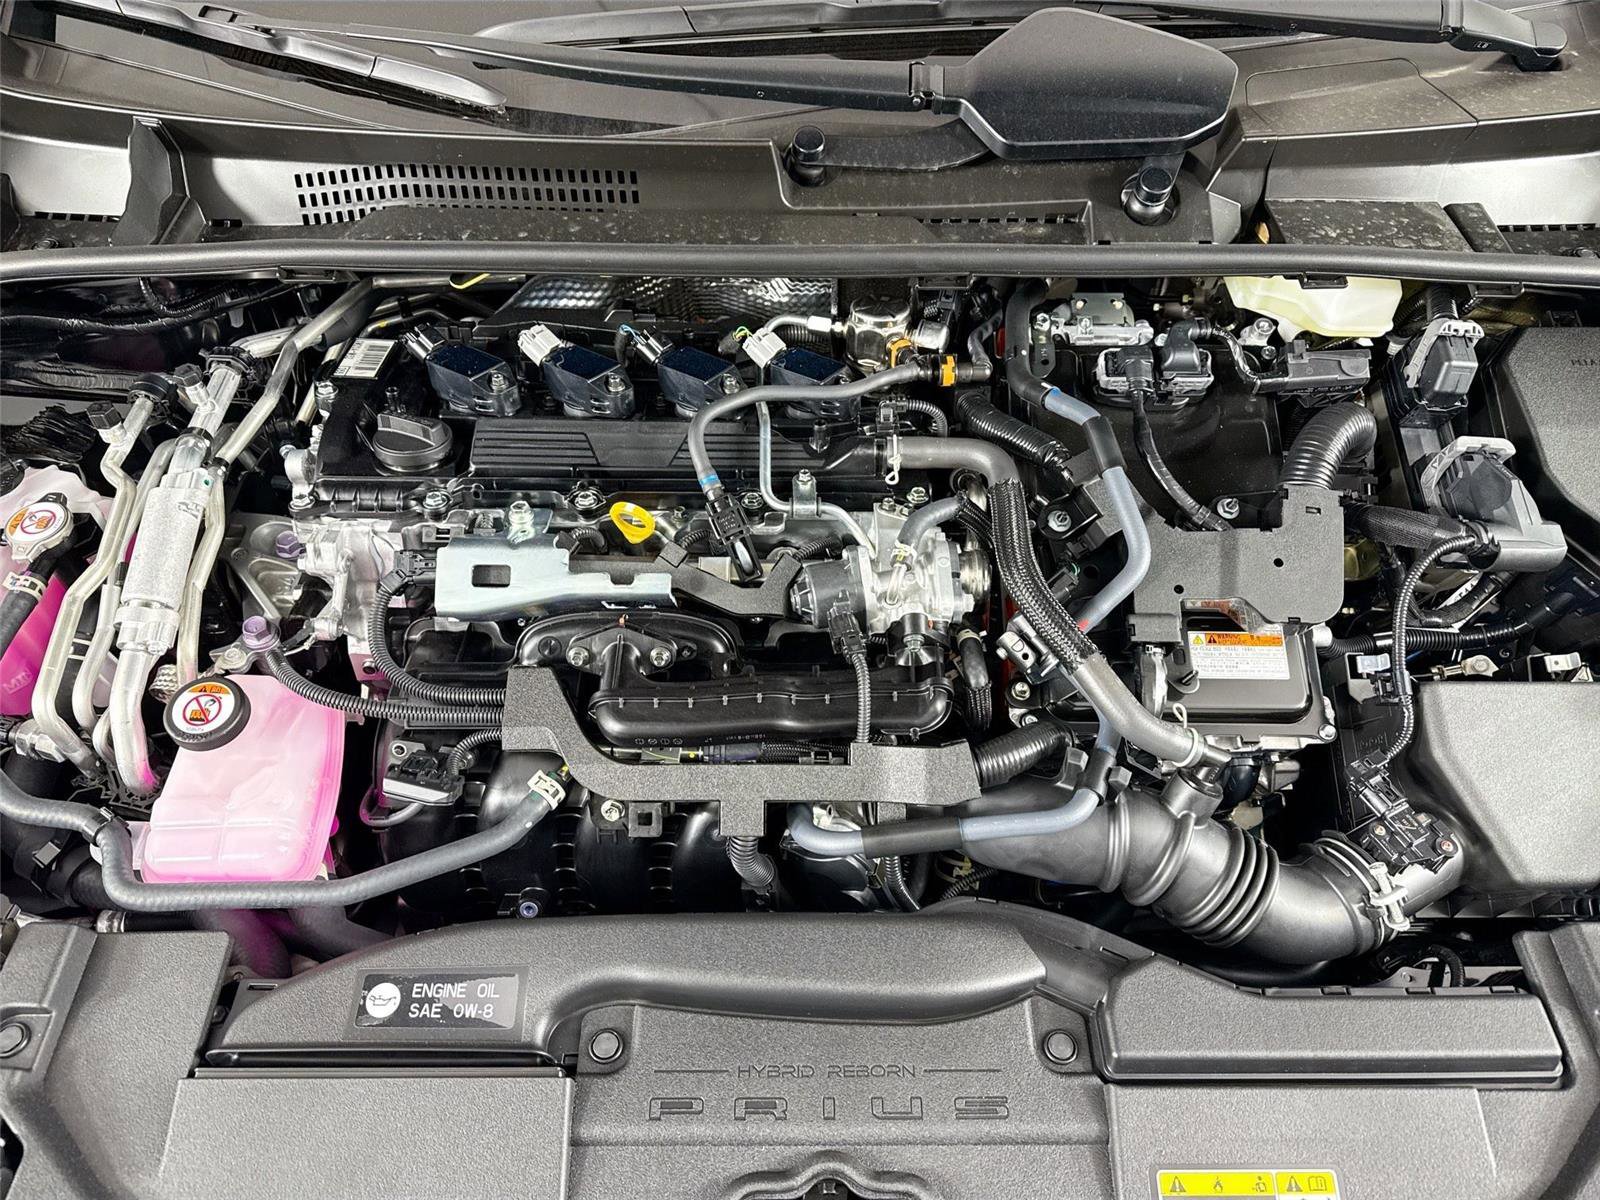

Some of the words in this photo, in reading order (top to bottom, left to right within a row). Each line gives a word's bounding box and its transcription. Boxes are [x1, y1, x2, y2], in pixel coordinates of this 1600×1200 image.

[412, 983, 467, 998] ENGINE
[477, 983, 500, 998] OIL
[408, 1003, 443, 1018] SAE
[453, 1003, 494, 1018] 0W-8
[737, 1064, 815, 1078] HYBRID
[827, 1064, 916, 1078] REBORN
[649, 1096, 1009, 1121] PRIUS
